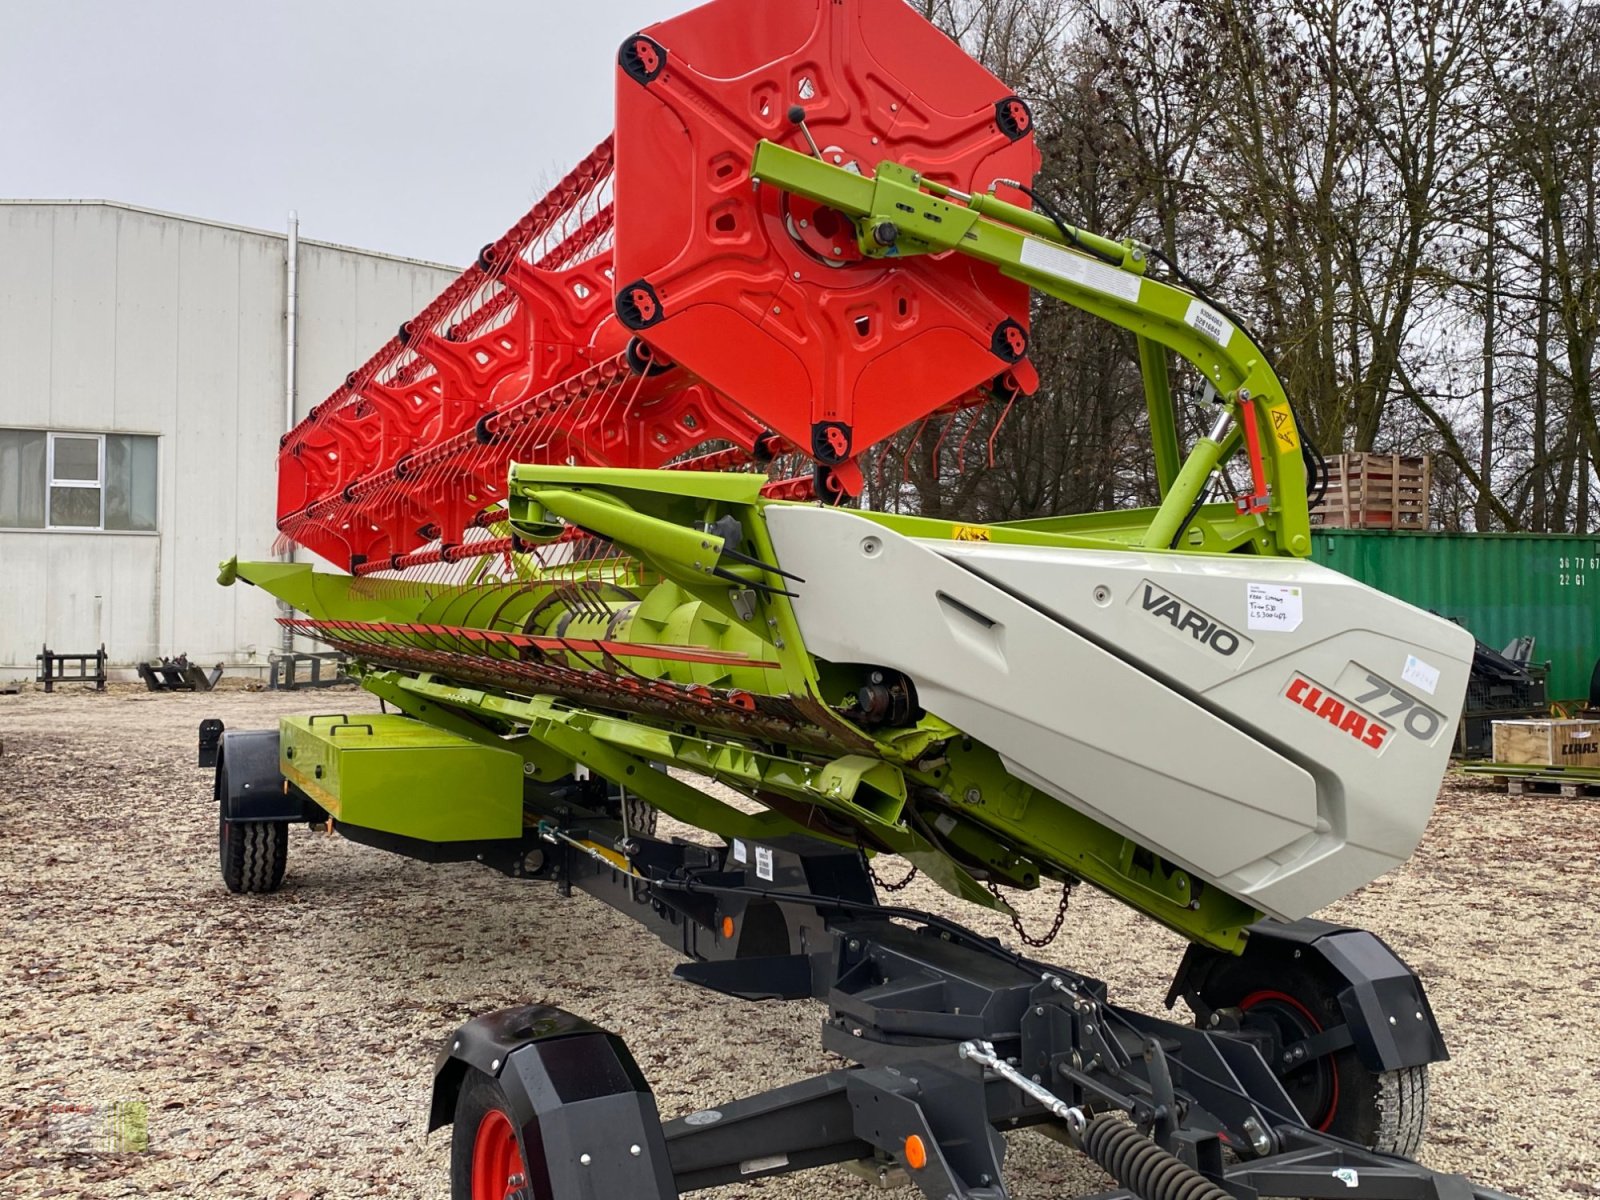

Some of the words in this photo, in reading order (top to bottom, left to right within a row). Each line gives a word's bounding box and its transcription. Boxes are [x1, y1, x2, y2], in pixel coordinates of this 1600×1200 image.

[1559, 573, 1570, 586] 22
[1575, 573, 1585, 586] G1
[1574, 557, 1585, 569] 77
[1590, 558, 1599, 569] 67
[1142, 585, 1239, 656] VARIO
[1285, 678, 1388, 750] CLAAS
[1354, 674, 1440, 741] 770
[1561, 742, 1598, 755] CLAAS
